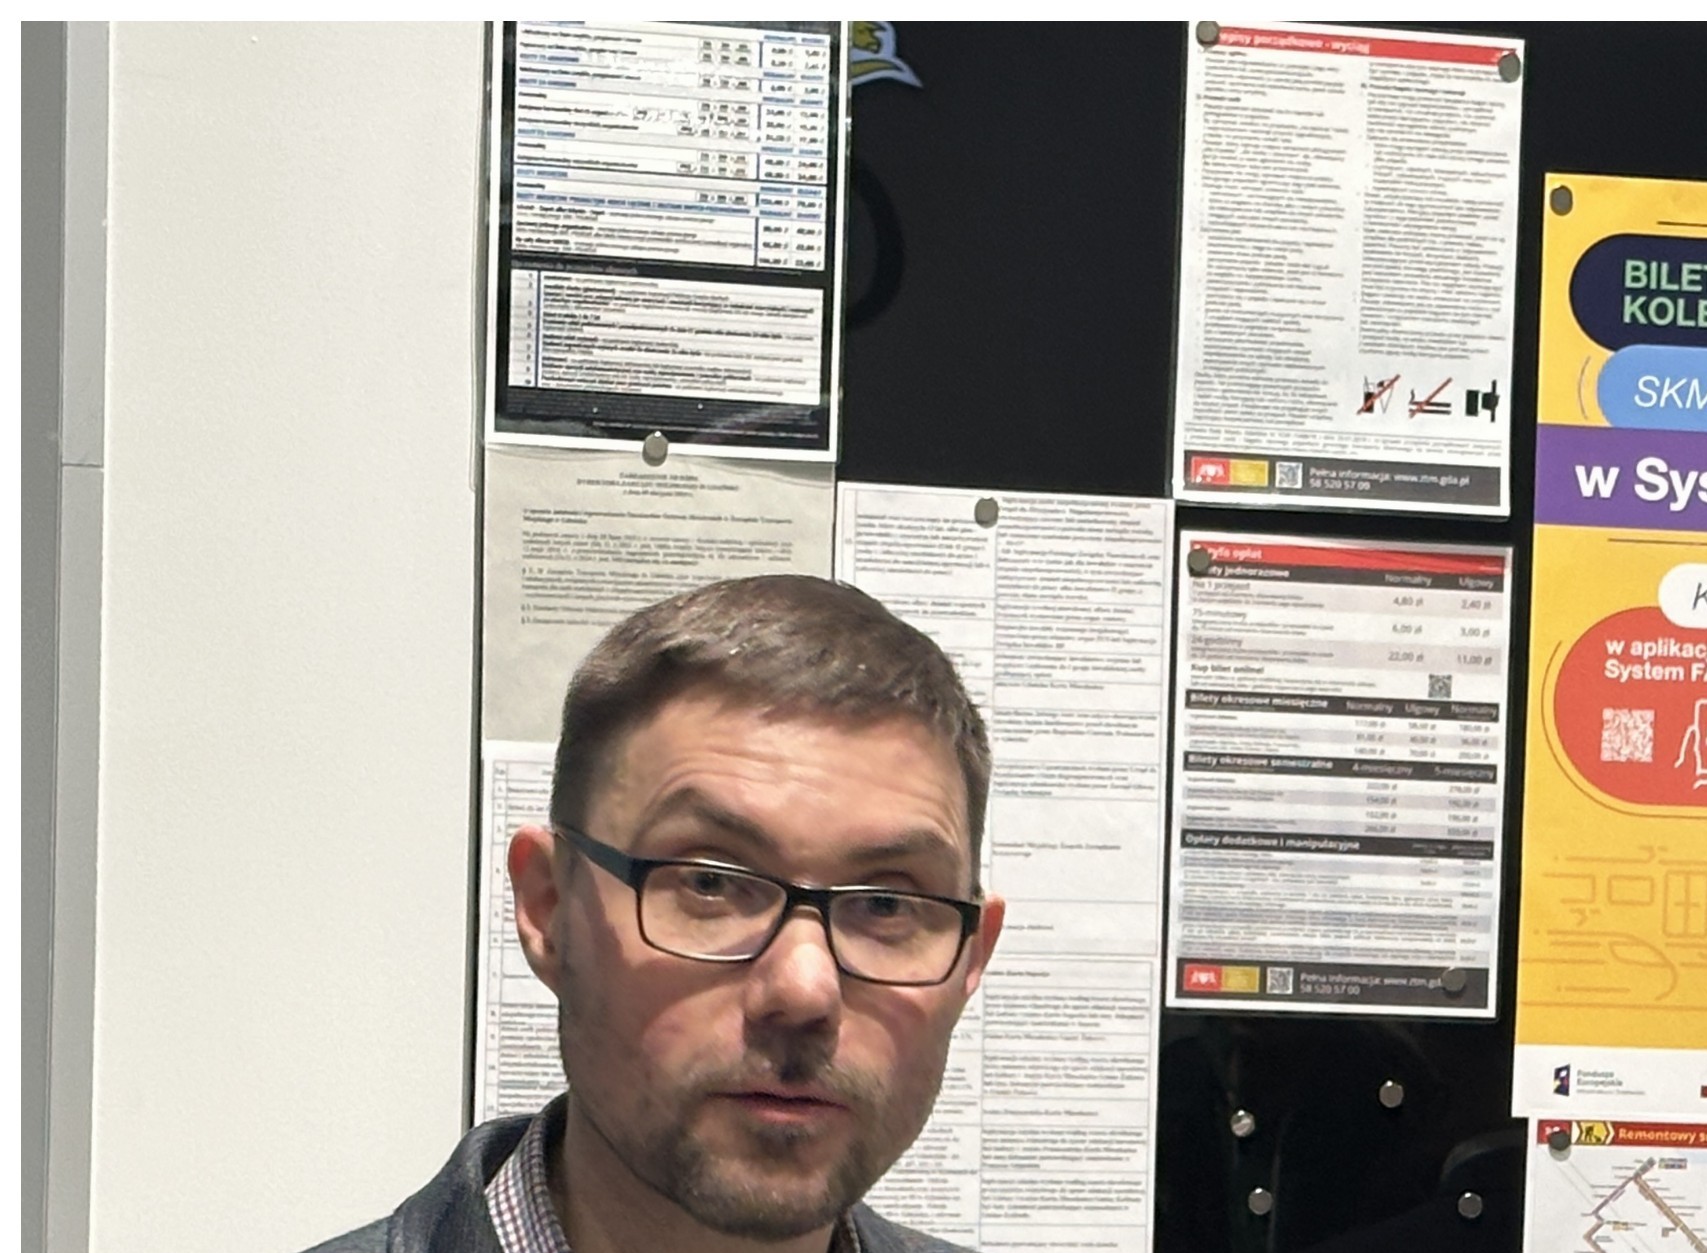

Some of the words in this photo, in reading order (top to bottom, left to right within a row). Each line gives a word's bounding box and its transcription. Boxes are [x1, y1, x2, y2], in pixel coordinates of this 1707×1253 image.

[1575, 466, 1620, 498] w
[1606, 643, 1624, 656] w
[1604, 659, 1685, 685] System
[1619, 1129, 1696, 1145] Remontowy
